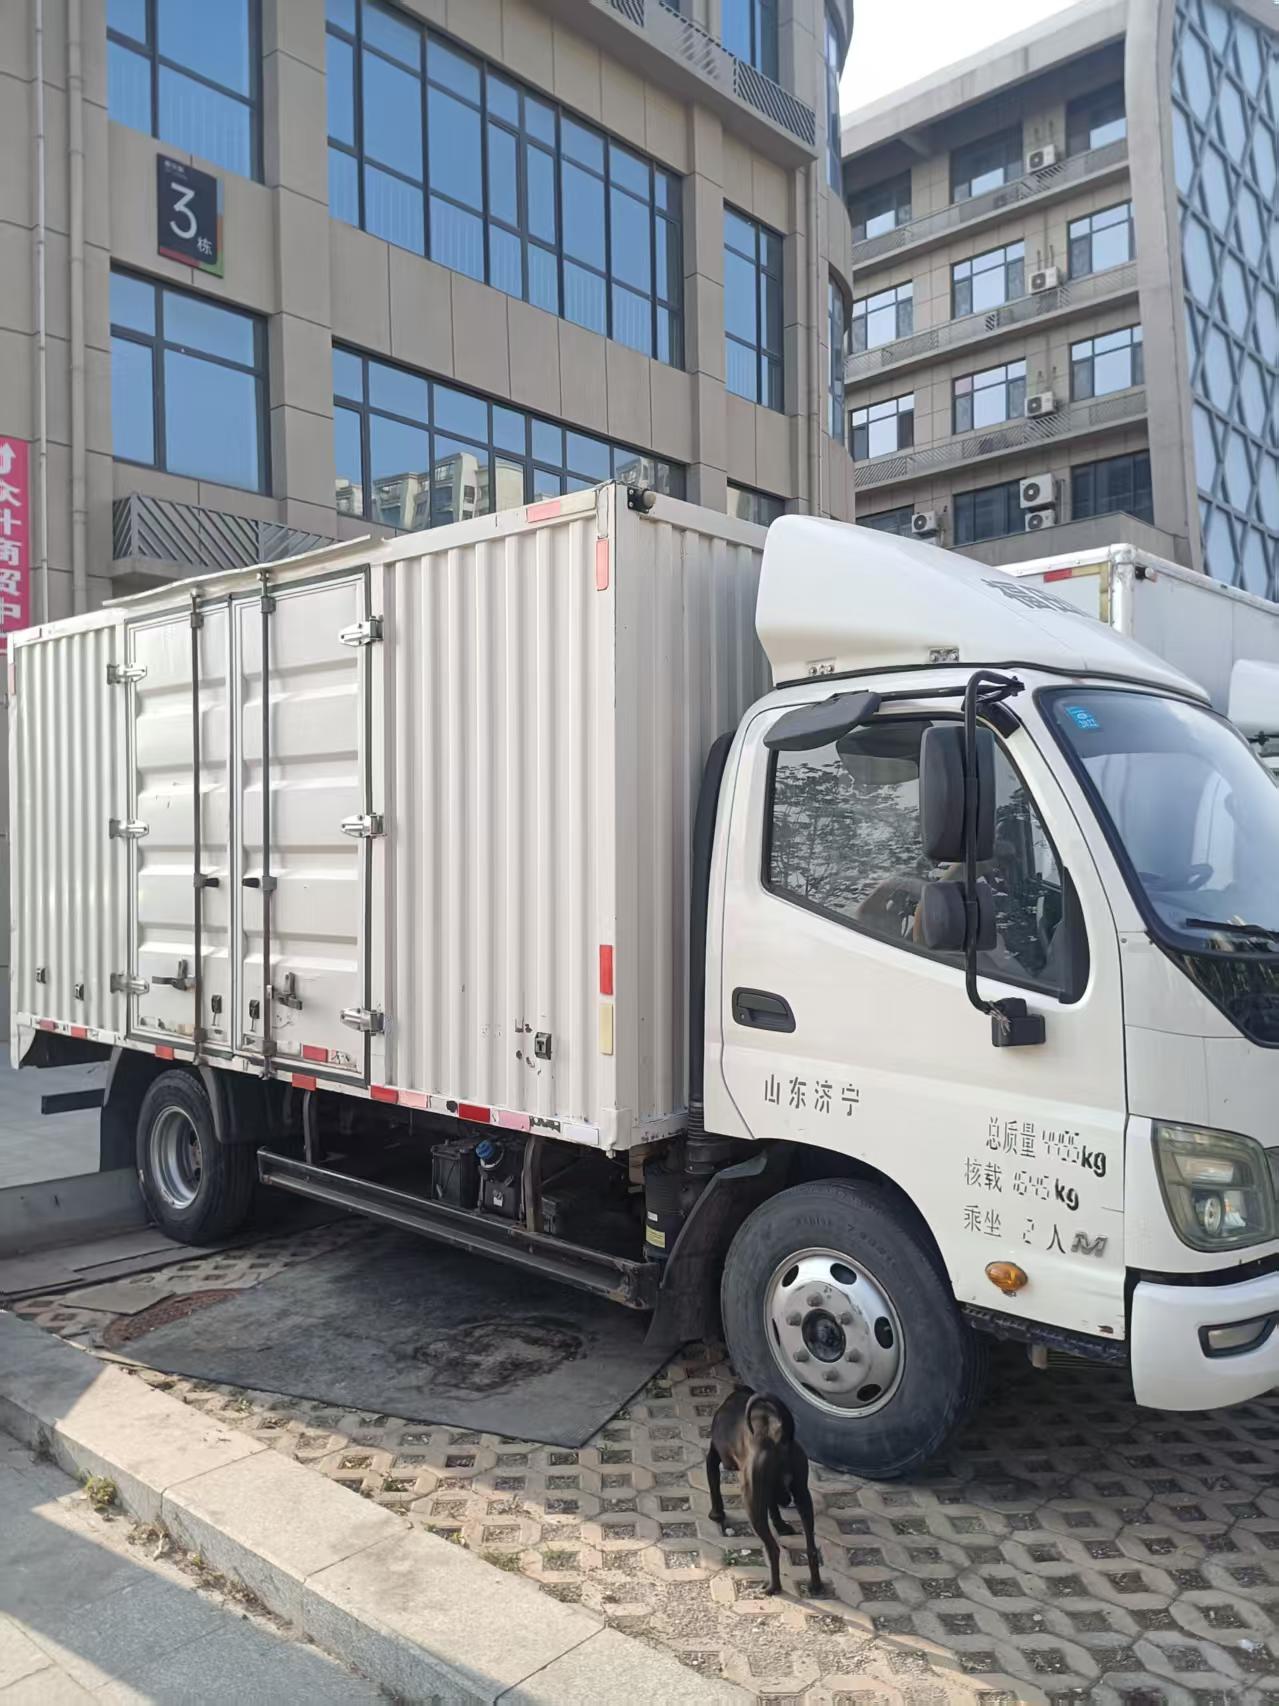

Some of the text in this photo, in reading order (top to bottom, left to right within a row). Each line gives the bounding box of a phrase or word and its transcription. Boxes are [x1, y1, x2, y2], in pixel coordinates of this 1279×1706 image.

[764, 1073, 860, 1117] 山东济宁
[985, 1116, 1036, 1159] 总质量
[964, 1156, 1003, 1193] 核载
[963, 1204, 1003, 1239] 乘坐
